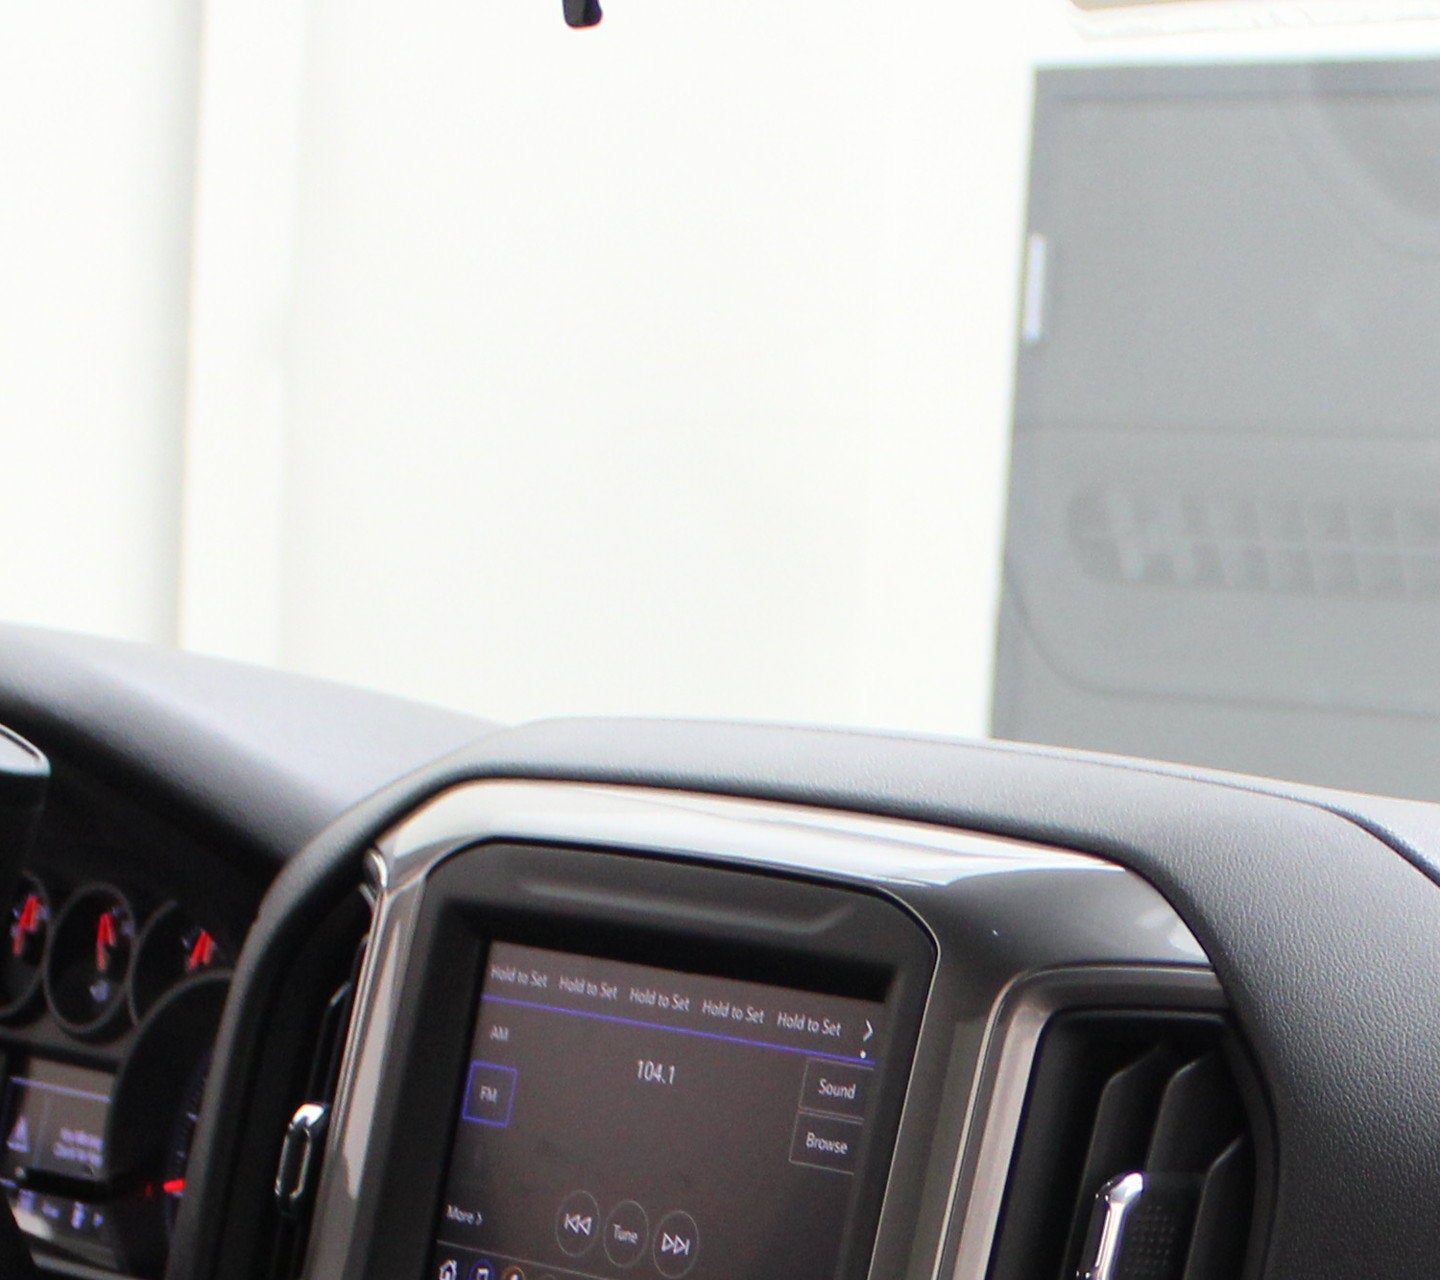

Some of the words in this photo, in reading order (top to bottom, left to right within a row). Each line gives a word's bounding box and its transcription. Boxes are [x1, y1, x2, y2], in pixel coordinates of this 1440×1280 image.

[559, 975, 585, 994] Hold
[586, 981, 598, 997] to
[600, 982, 618, 1000] Set
[629, 987, 656, 1005] Hold
[657, 993, 670, 1009] to
[671, 993, 690, 1012] Set
[702, 999, 730, 1018] Hold
[731, 1006, 744, 1021] to
[745, 1006, 765, 1024] Set
[777, 1011, 806, 1031] Hold
[807, 1017, 820, 1032] to
[821, 1018, 841, 1037] Set
[637, 1059, 676, 1085] 104.1
[818, 1077, 856, 1099] Sound
[805, 1131, 848, 1155] Browse
[613, 1223, 639, 1244] Tune
